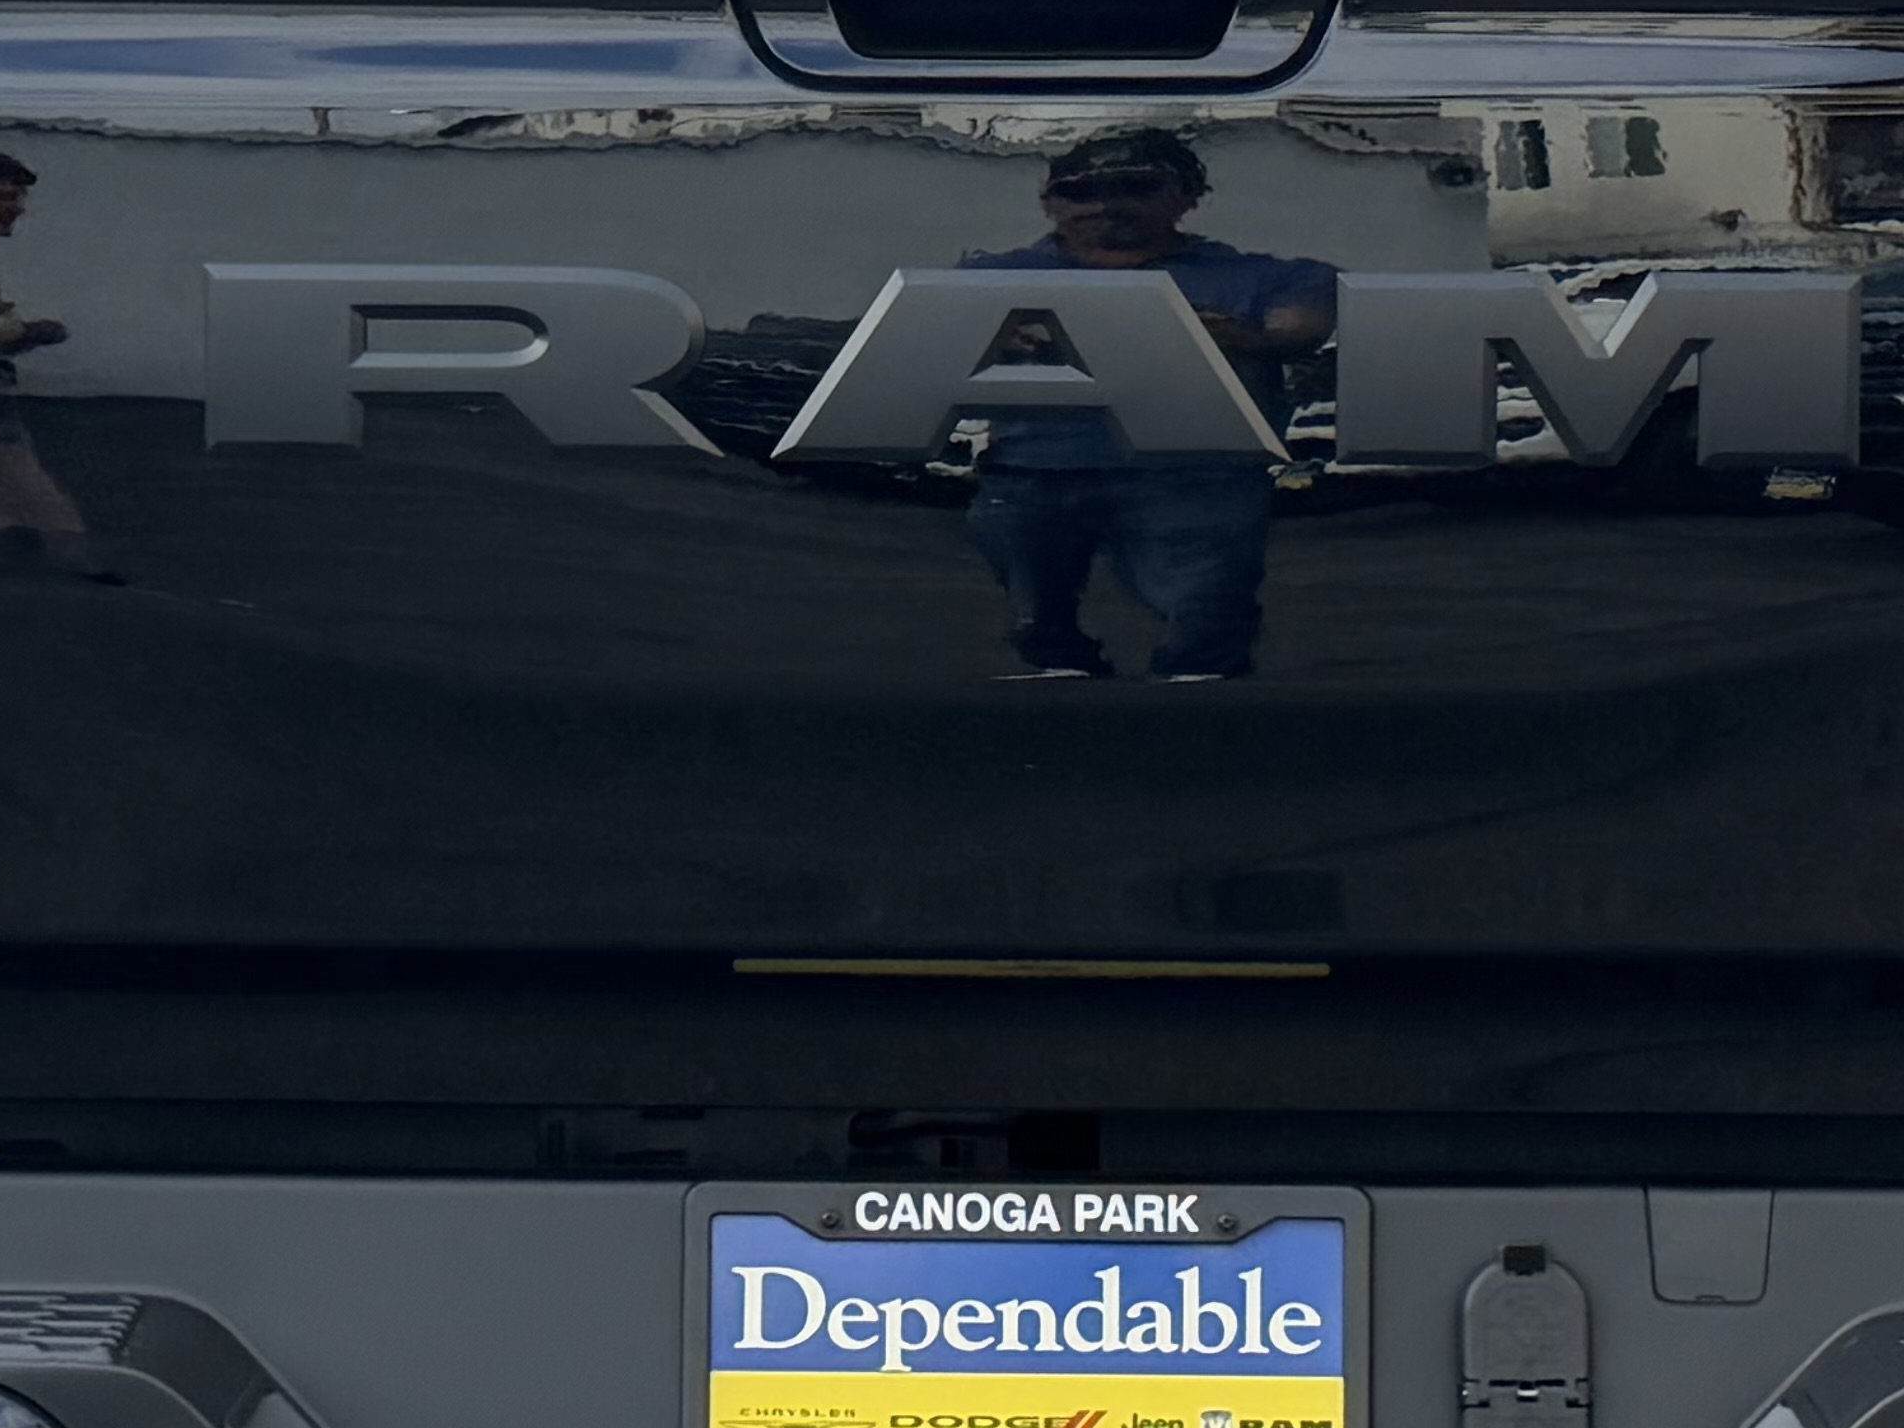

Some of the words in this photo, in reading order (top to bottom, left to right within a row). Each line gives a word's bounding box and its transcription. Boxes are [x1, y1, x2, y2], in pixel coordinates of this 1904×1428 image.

[204, 263, 1864, 470] RAM
[854, 1191, 1061, 1233] CANOGA
[1073, 1193, 1200, 1233] PARK
[731, 1265, 1322, 1373] Dependable
[739, 1407, 857, 1418] CHRYSLER
